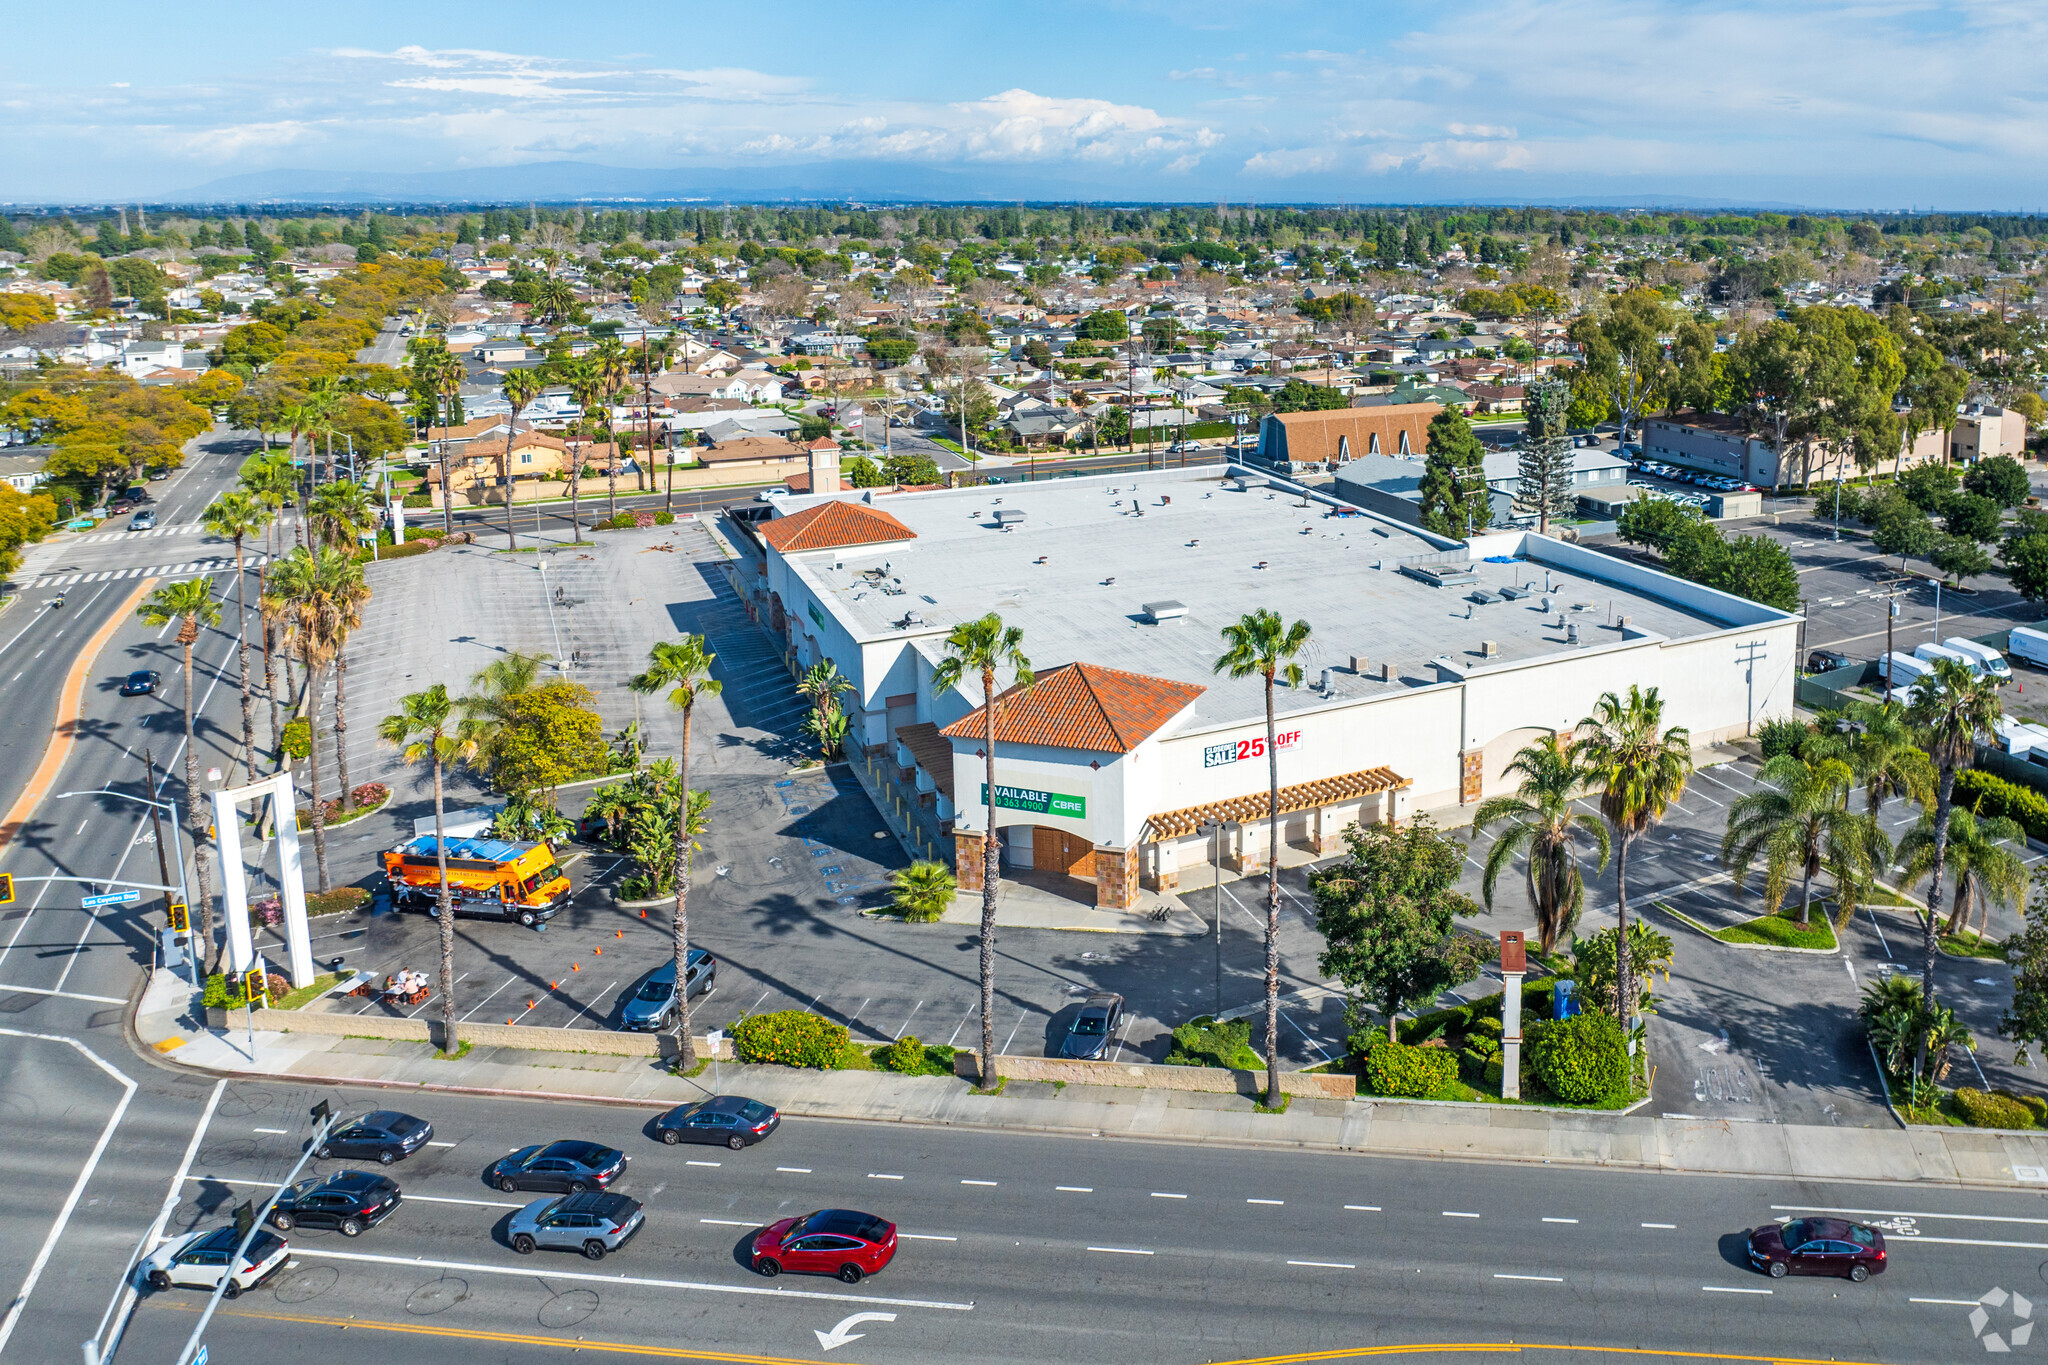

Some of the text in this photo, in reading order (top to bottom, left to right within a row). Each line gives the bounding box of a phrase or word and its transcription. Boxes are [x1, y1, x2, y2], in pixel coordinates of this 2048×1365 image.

[1277, 730, 1301, 745] OFF
[1205, 750, 1236, 767] SALE
[986, 786, 1048, 803] VAILABLE
[1003, 798, 1020, 808] 363
[1021, 800, 1044, 811] 4900
[1052, 800, 1082, 812] CBRE
[97, 895, 122, 904] Coyotes
